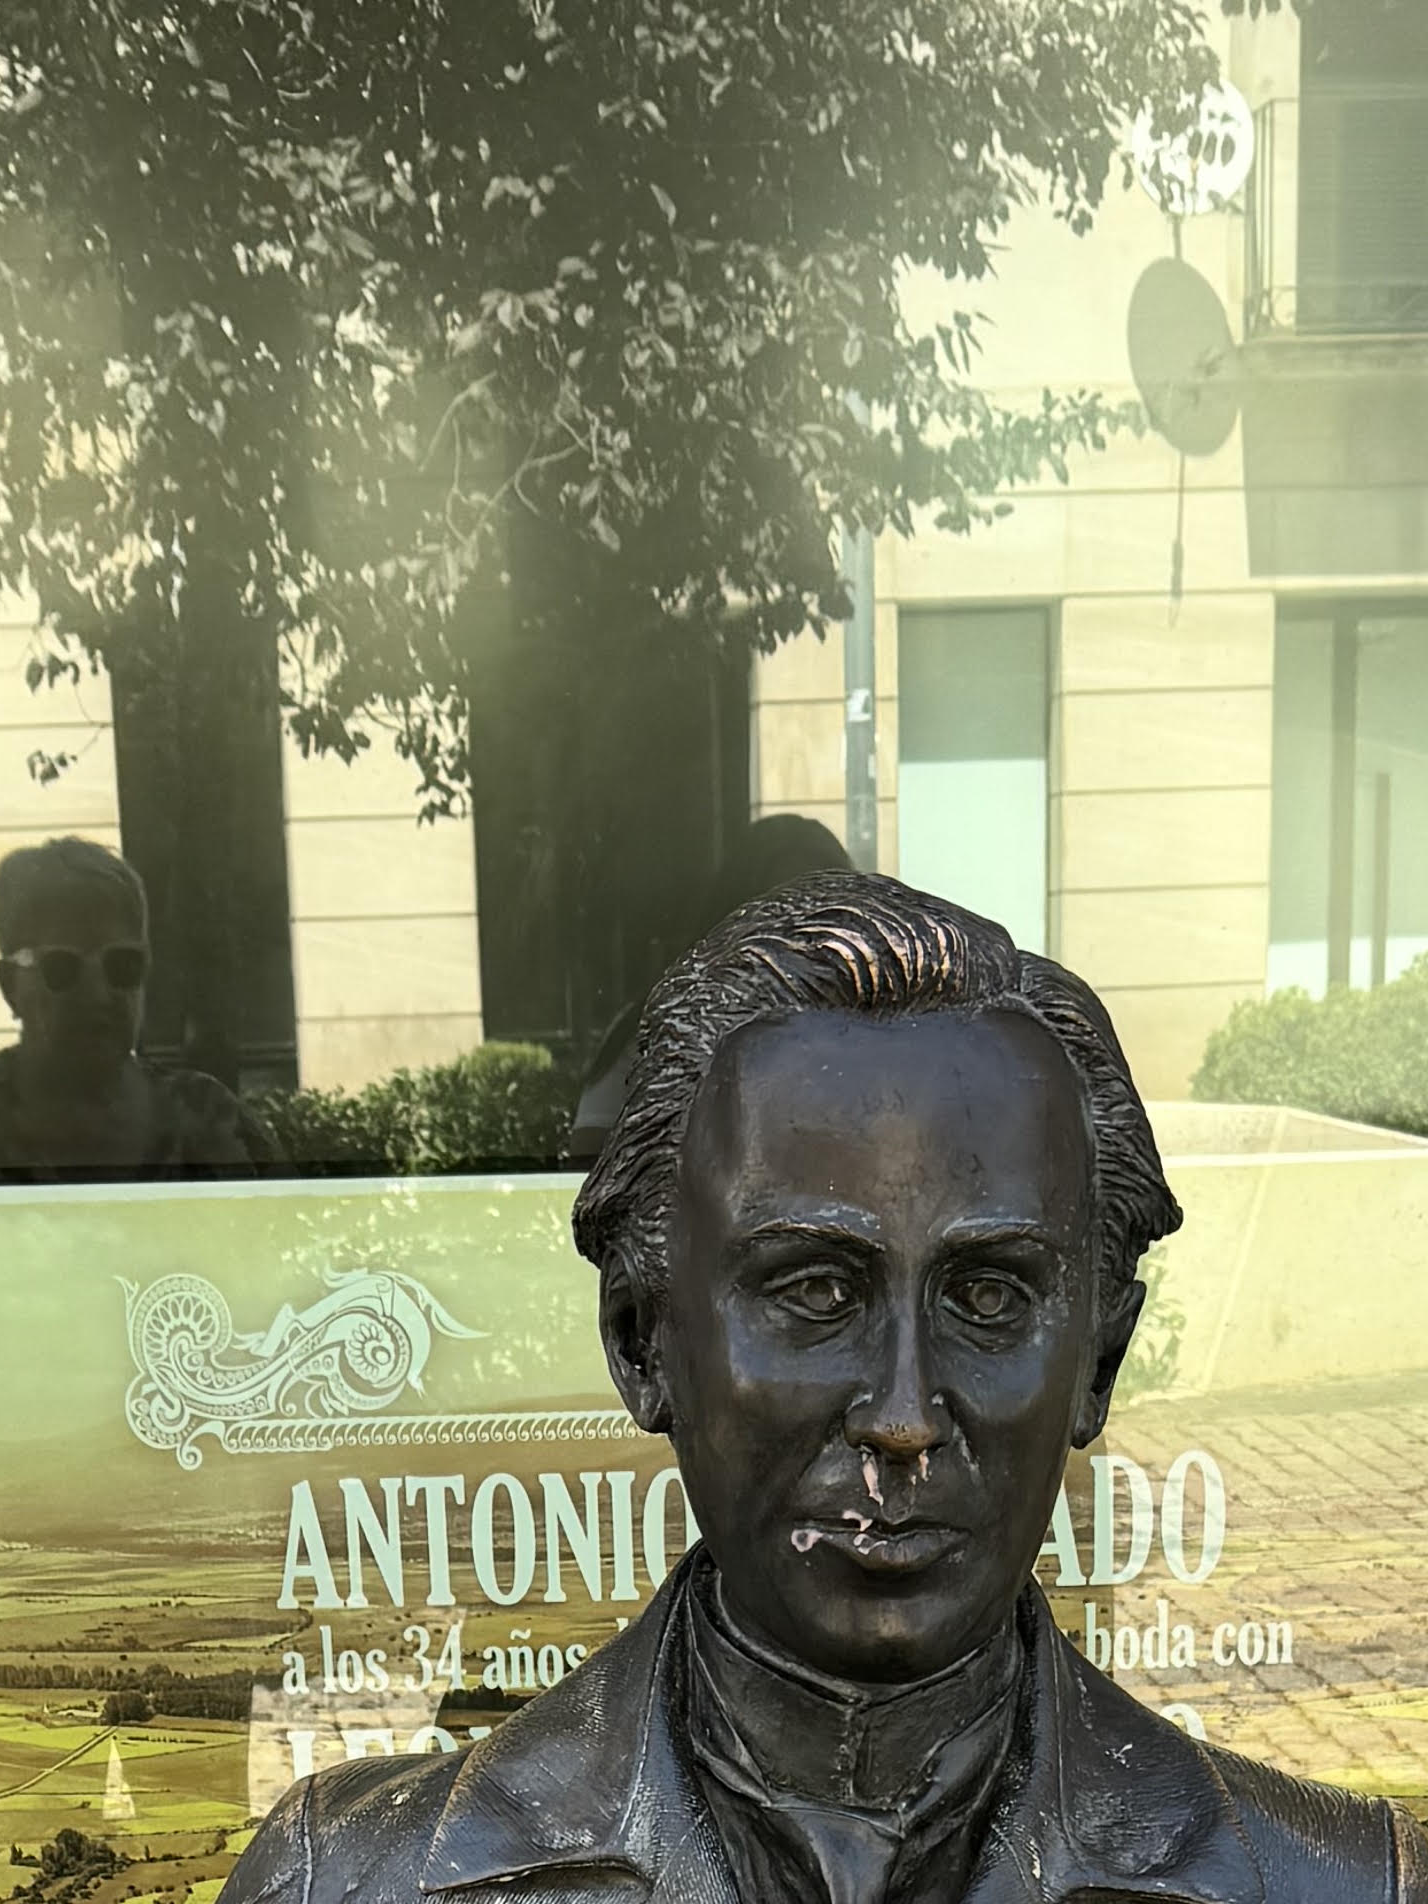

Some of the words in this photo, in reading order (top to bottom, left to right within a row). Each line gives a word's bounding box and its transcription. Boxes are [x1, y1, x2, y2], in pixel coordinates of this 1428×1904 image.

[277, 1468, 703, 1609] ANTONIO
[283, 1650, 309, 1695] a
[320, 1625, 387, 1693] los
[403, 1619, 467, 1691] 34
[1085, 1599, 1197, 1671] boda
[1212, 1621, 1293, 1666] con
